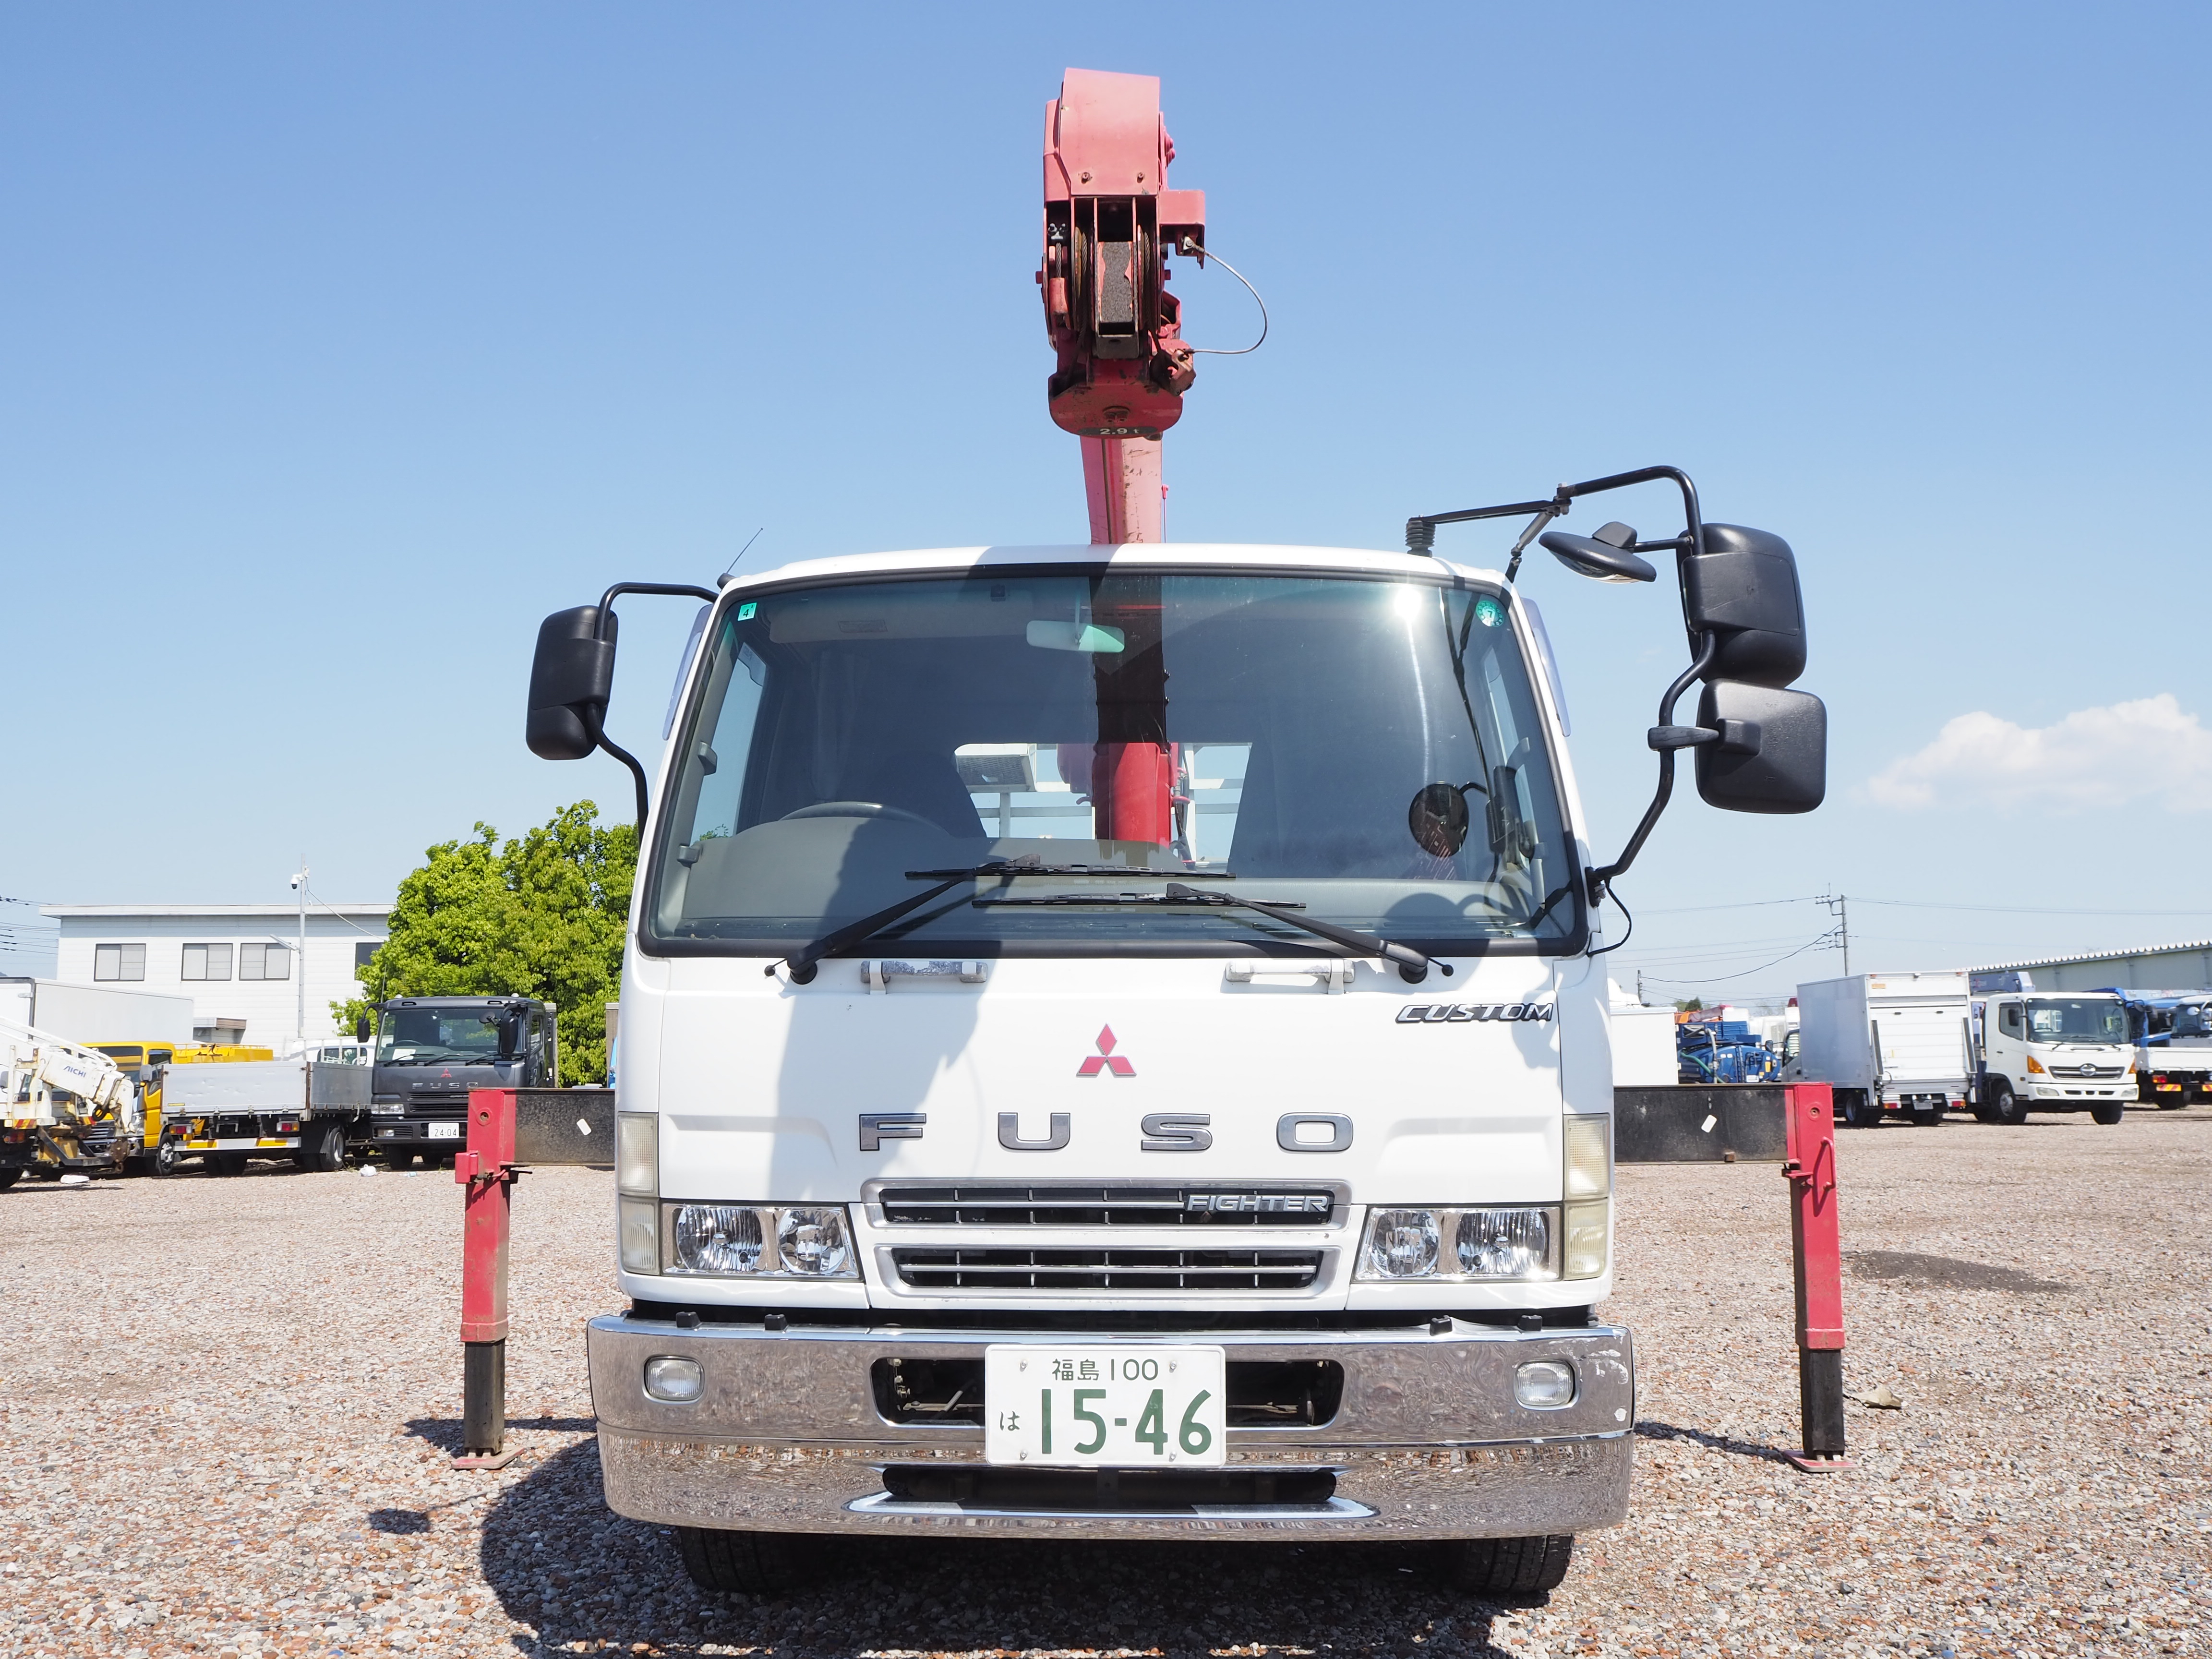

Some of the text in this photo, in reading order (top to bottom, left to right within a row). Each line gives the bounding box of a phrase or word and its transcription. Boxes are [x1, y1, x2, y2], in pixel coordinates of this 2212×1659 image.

[743, 609, 749, 617] 4
[1487, 610, 1493, 618] 7
[1396, 1003, 1553, 1022] CUSTOM
[63, 1066, 86, 1078] AICHI
[858, 1112, 1354, 1153] FUSO
[1187, 1195, 1328, 1212] FIGHTER
[1052, 1358, 1158, 1381] 福島 100
[1000, 1411, 1020, 1431] は
[1041, 1389, 1212, 1455] 15-46
